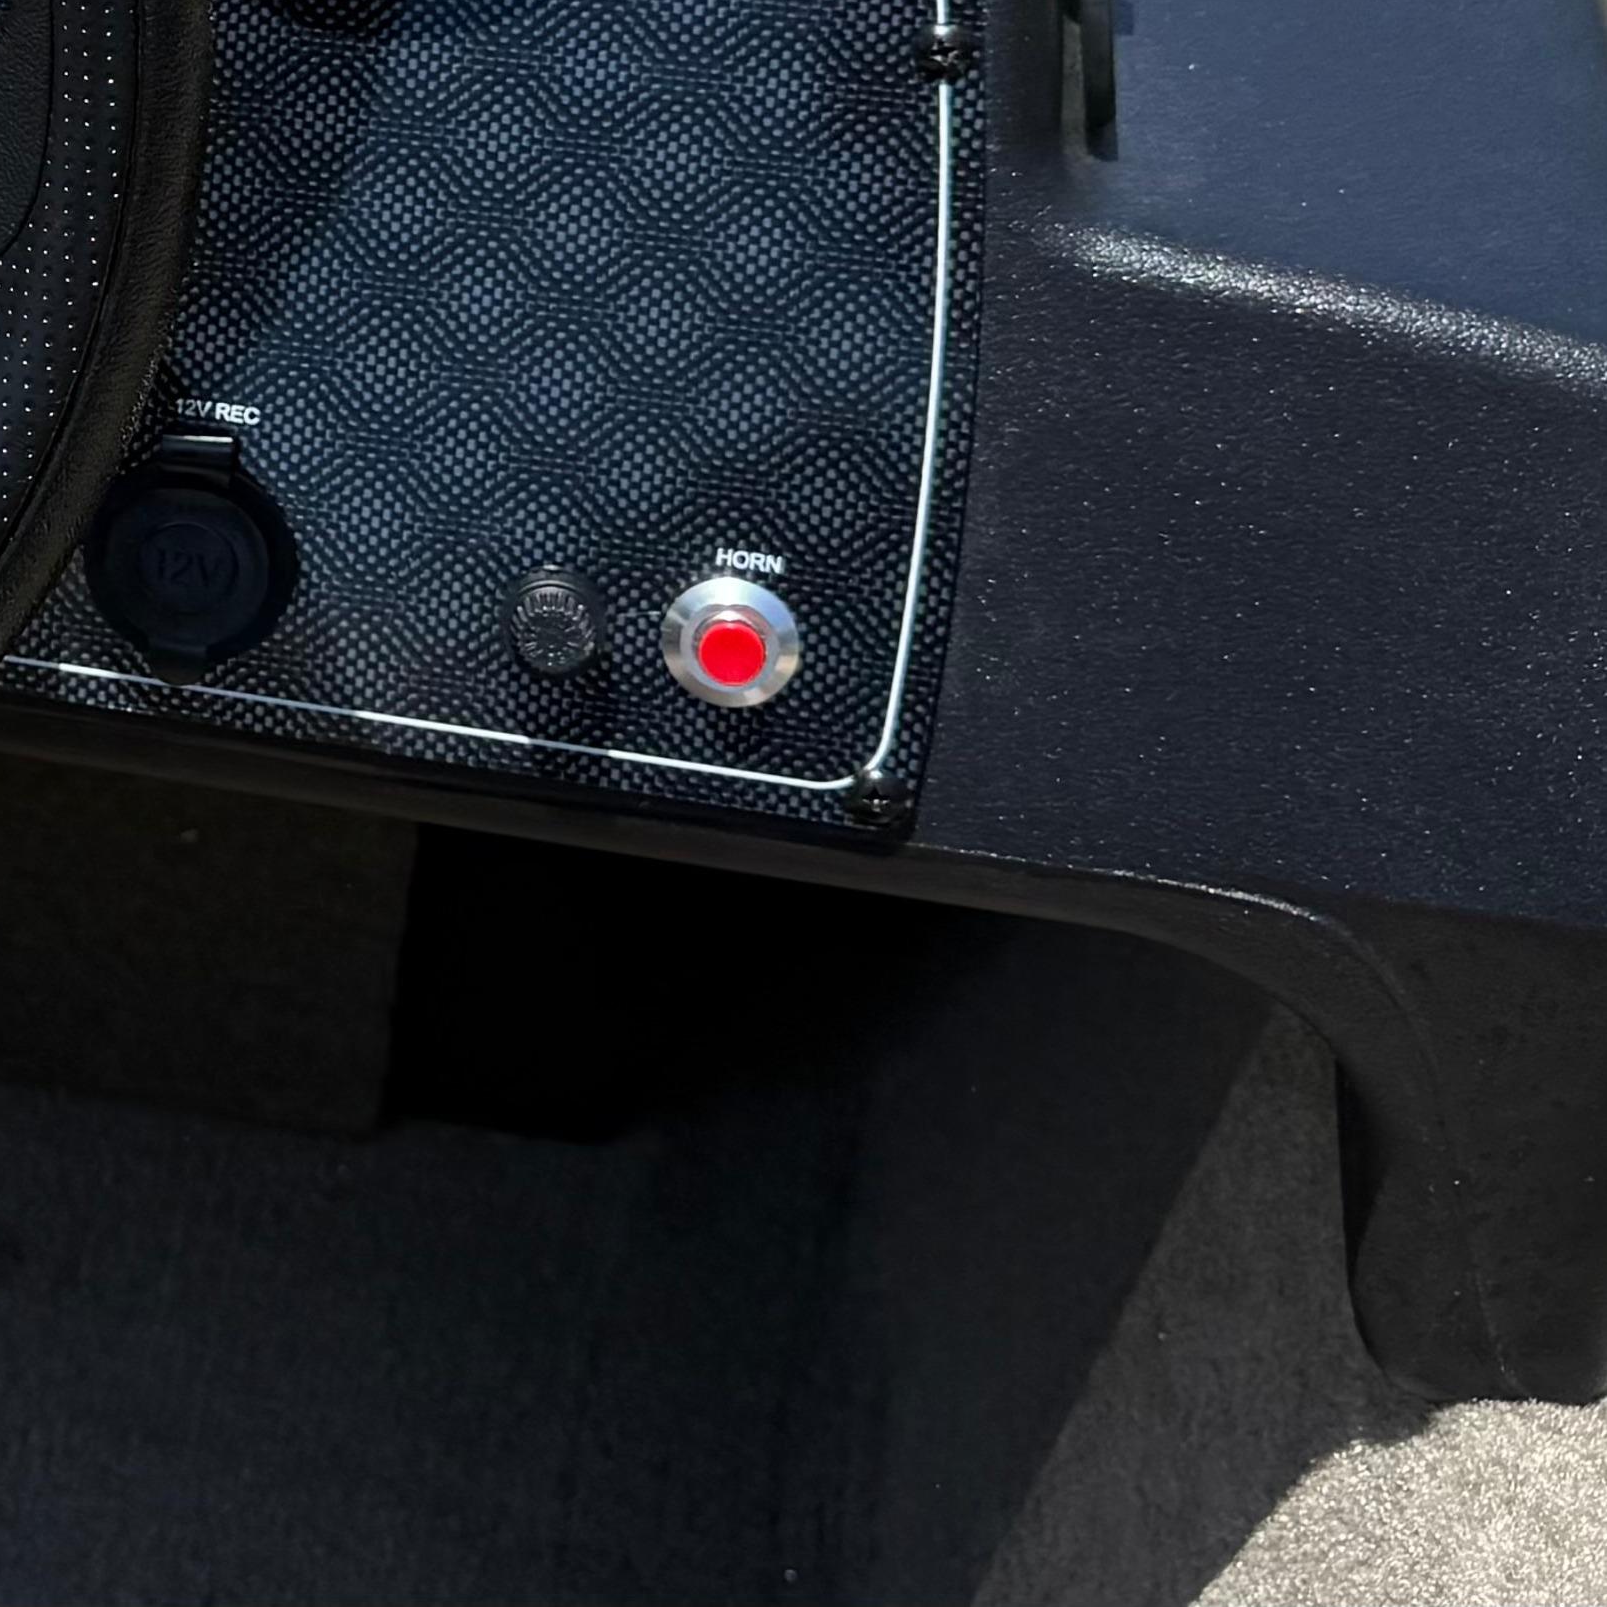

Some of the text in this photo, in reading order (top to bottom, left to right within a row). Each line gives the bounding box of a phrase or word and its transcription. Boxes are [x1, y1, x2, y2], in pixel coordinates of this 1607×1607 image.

[174, 397, 262, 426] 12V REC
[159, 549, 219, 586] 12V
[716, 547, 783, 573] HORN
